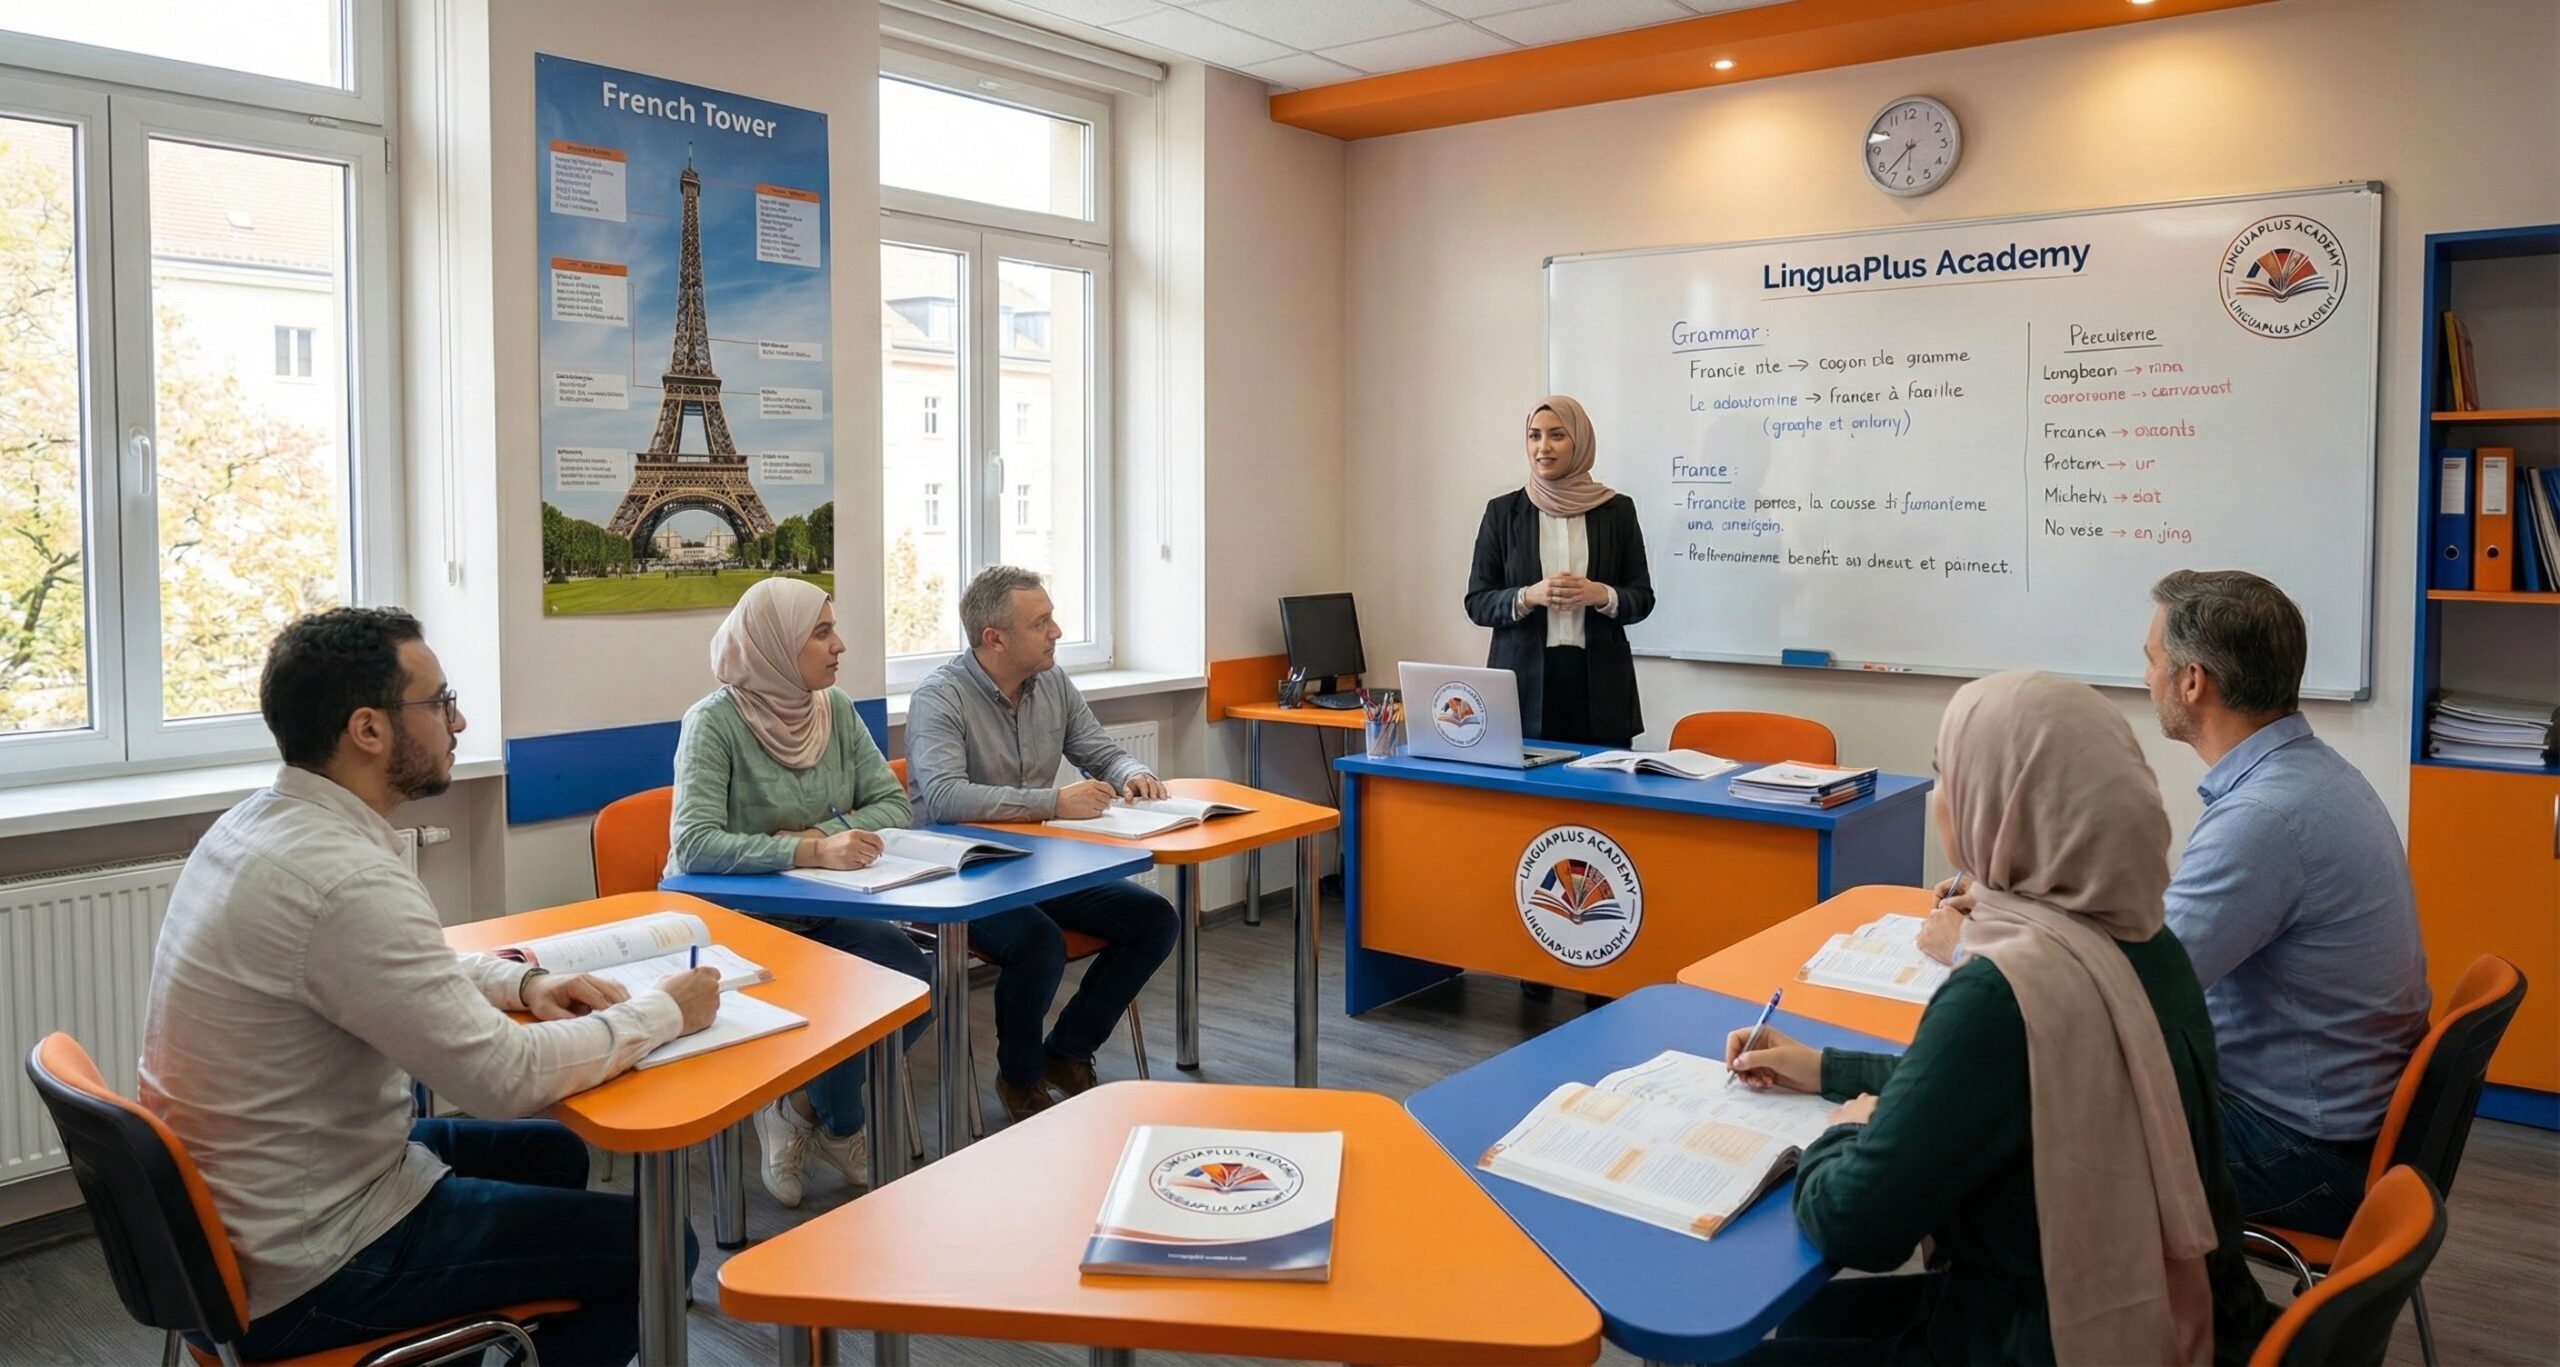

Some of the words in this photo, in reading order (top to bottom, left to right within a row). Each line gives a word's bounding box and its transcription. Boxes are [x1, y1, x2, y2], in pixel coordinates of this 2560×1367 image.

[602, 81, 696, 124] French
[702, 101, 777, 138] Tower
[1904, 108, 1917, 120] 12
[1890, 115, 1898, 127] 11
[1934, 122, 1943, 133] 2
[1872, 146, 1881, 156] 9
[1940, 138, 1948, 149] 3
[1878, 162, 1886, 173] 8
[1923, 169, 1931, 180] 5
[1906, 175, 1915, 185] 6
[2224, 219, 2292, 275] LINGUAPLUS
[2294, 222, 2342, 267] ACADEMY
[1763, 253, 1927, 292] LinguaPlus
[1936, 243, 2091, 275] Academy
[1690, 360, 1745, 379] Francie
[1907, 351, 1970, 369] gramme
[1690, 394, 1705, 411] Le
[1888, 386, 1899, 401] à
[1829, 416, 1843, 431] et
[1809, 493, 1824, 509] la
[2044, 518, 2065, 537] No
[2134, 528, 2153, 540] en
[1788, 548, 1839, 566] benefit
[1919, 556, 1936, 570] et
[1519, 829, 1586, 880] LINGUAPLUS
[1587, 835, 1638, 897] ACADEMY
